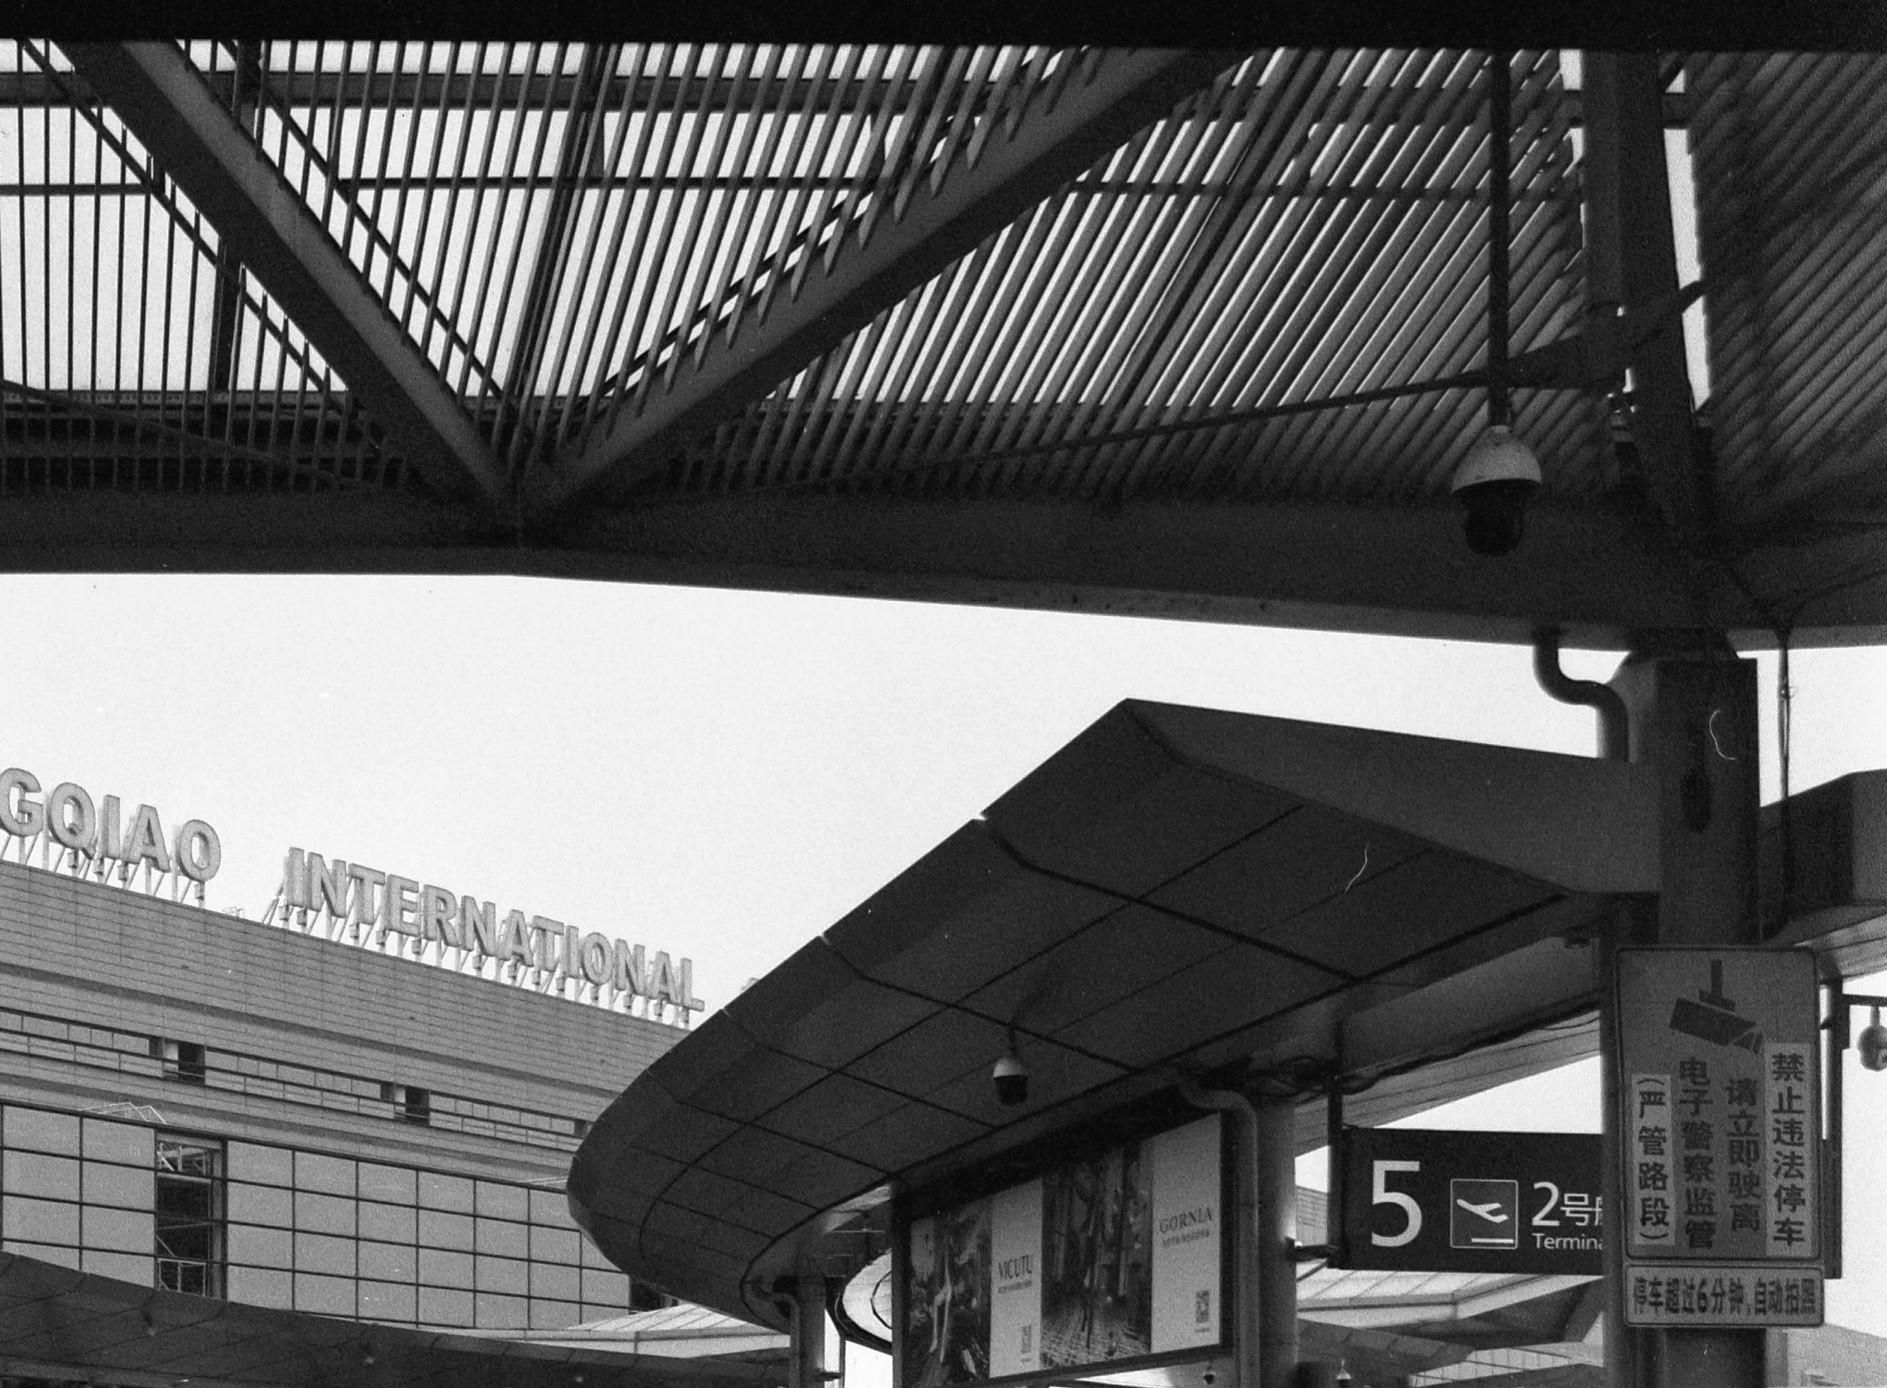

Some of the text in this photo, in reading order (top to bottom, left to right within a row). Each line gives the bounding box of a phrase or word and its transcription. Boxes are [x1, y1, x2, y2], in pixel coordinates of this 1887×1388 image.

[284, 846, 705, 1012] INTERNATIONAL
[1370, 1159, 1423, 1249] 5
[1532, 1181, 1603, 1227] 2号
[1678, 1055, 1718, 1250] 电子警察监管
[1725, 1077, 1762, 1232] 请立即驶离
[1771, 1052, 1806, 1248] 禁止违法停车
